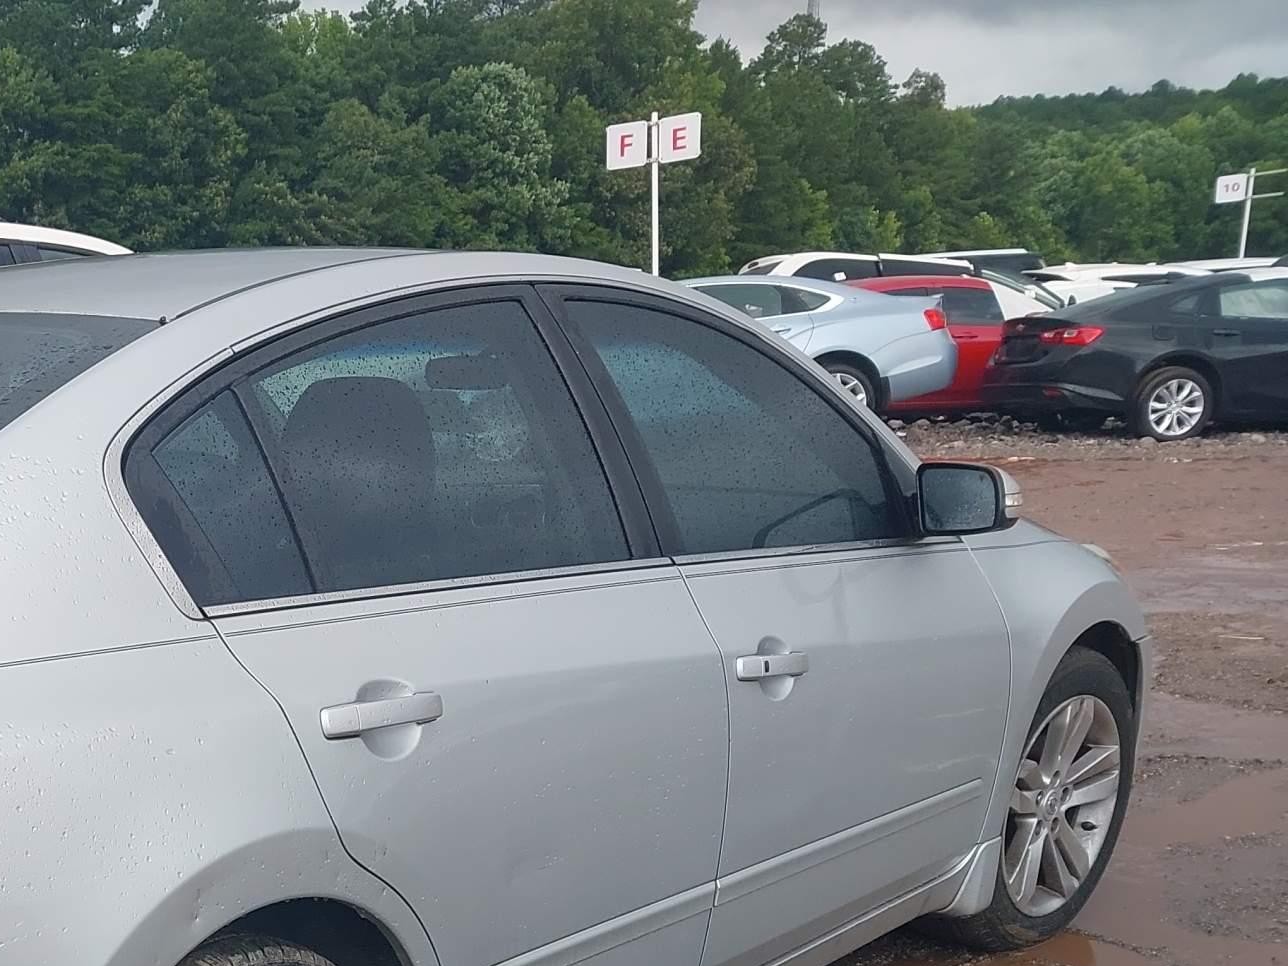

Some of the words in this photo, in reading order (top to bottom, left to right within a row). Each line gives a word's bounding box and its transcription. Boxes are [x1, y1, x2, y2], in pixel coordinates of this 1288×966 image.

[619, 133, 634, 158] F
[672, 126, 687, 151] E
[1223, 182, 1241, 193] 10
